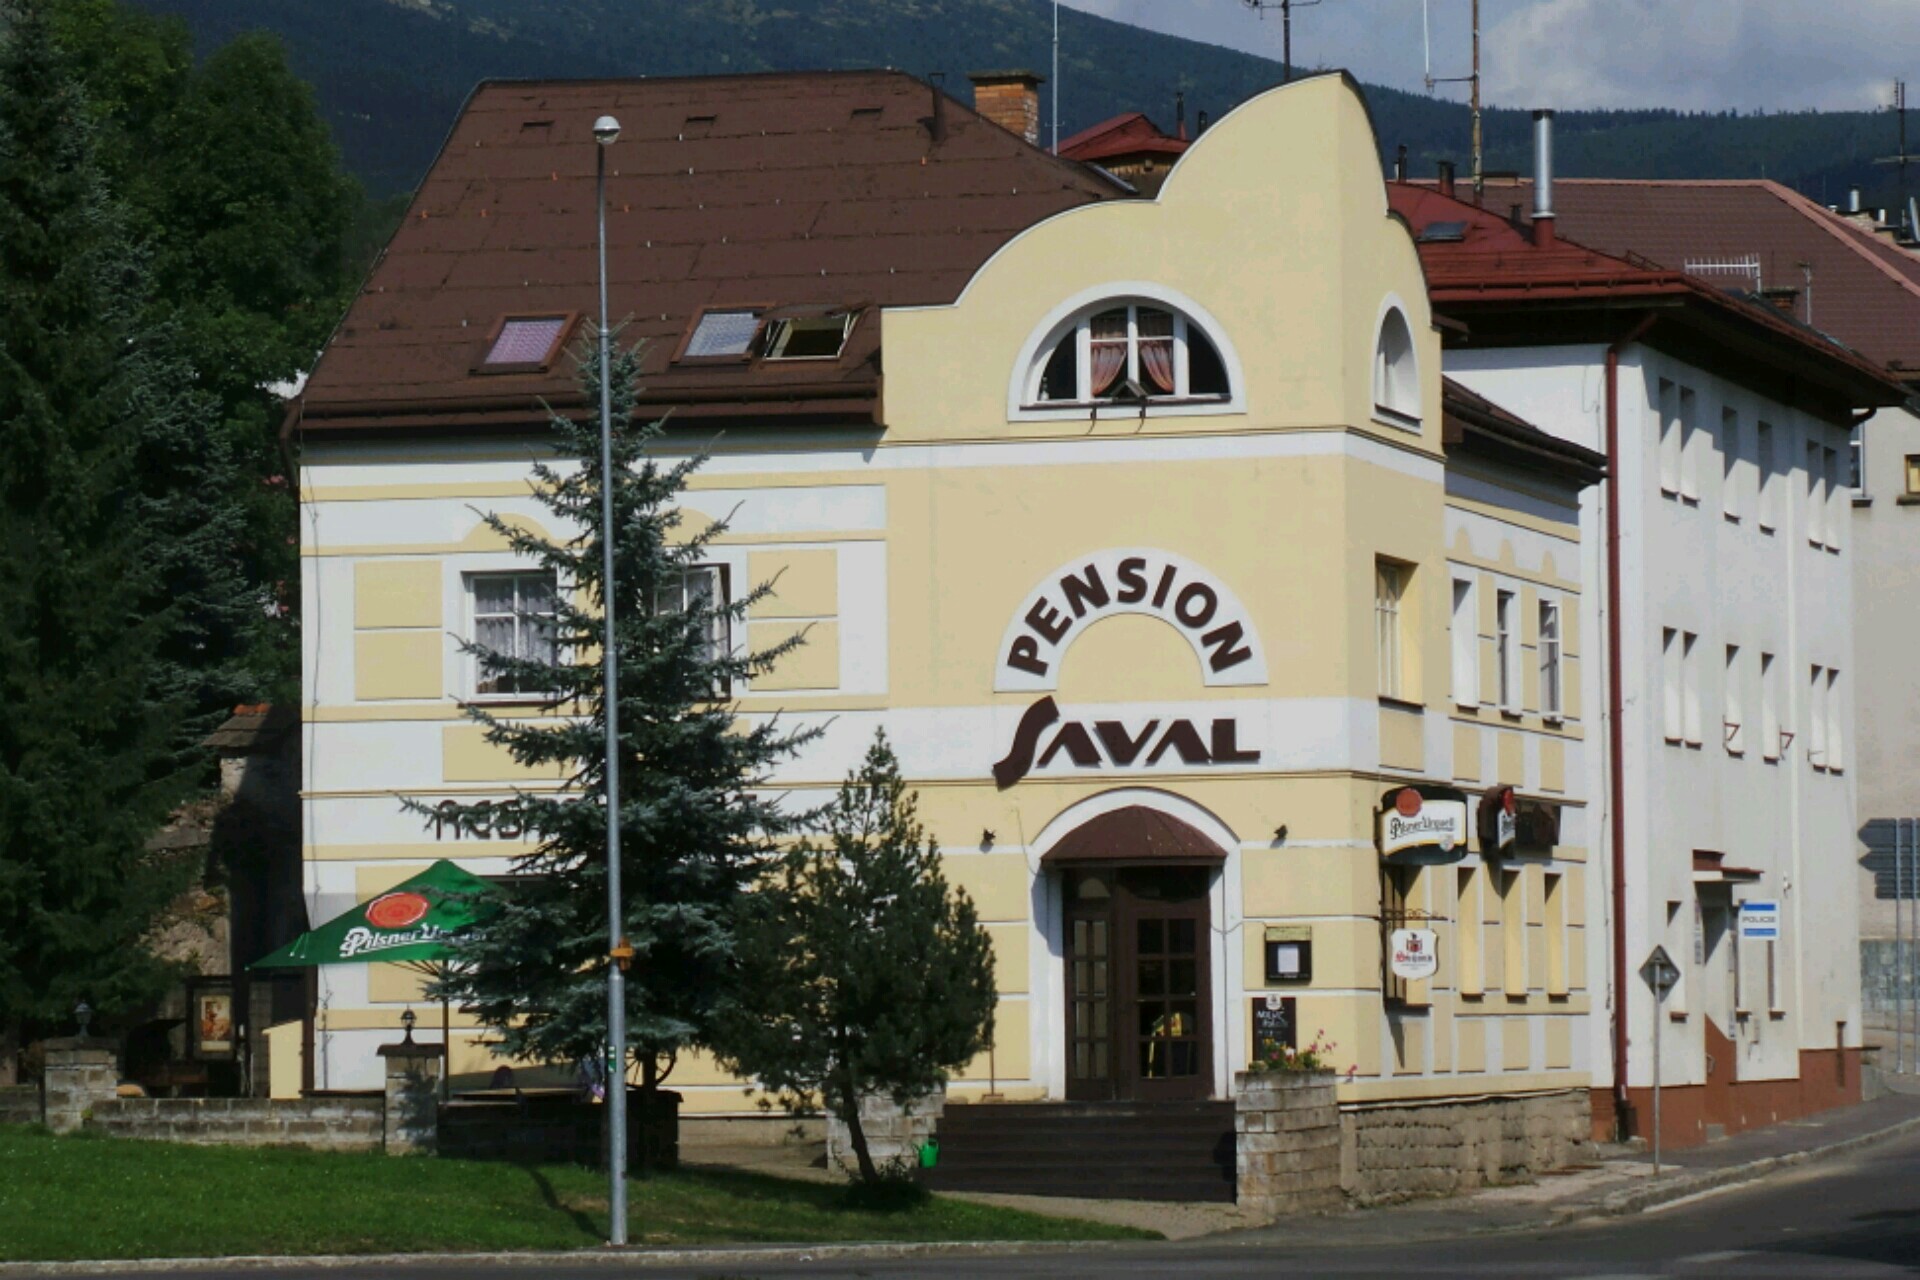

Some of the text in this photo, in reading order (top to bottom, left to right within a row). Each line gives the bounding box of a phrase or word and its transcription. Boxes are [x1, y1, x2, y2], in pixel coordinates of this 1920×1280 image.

[1007, 557, 1252, 677] PENSION
[991, 695, 1260, 792] SAVAL
[339, 926, 420, 958] Pilsner
